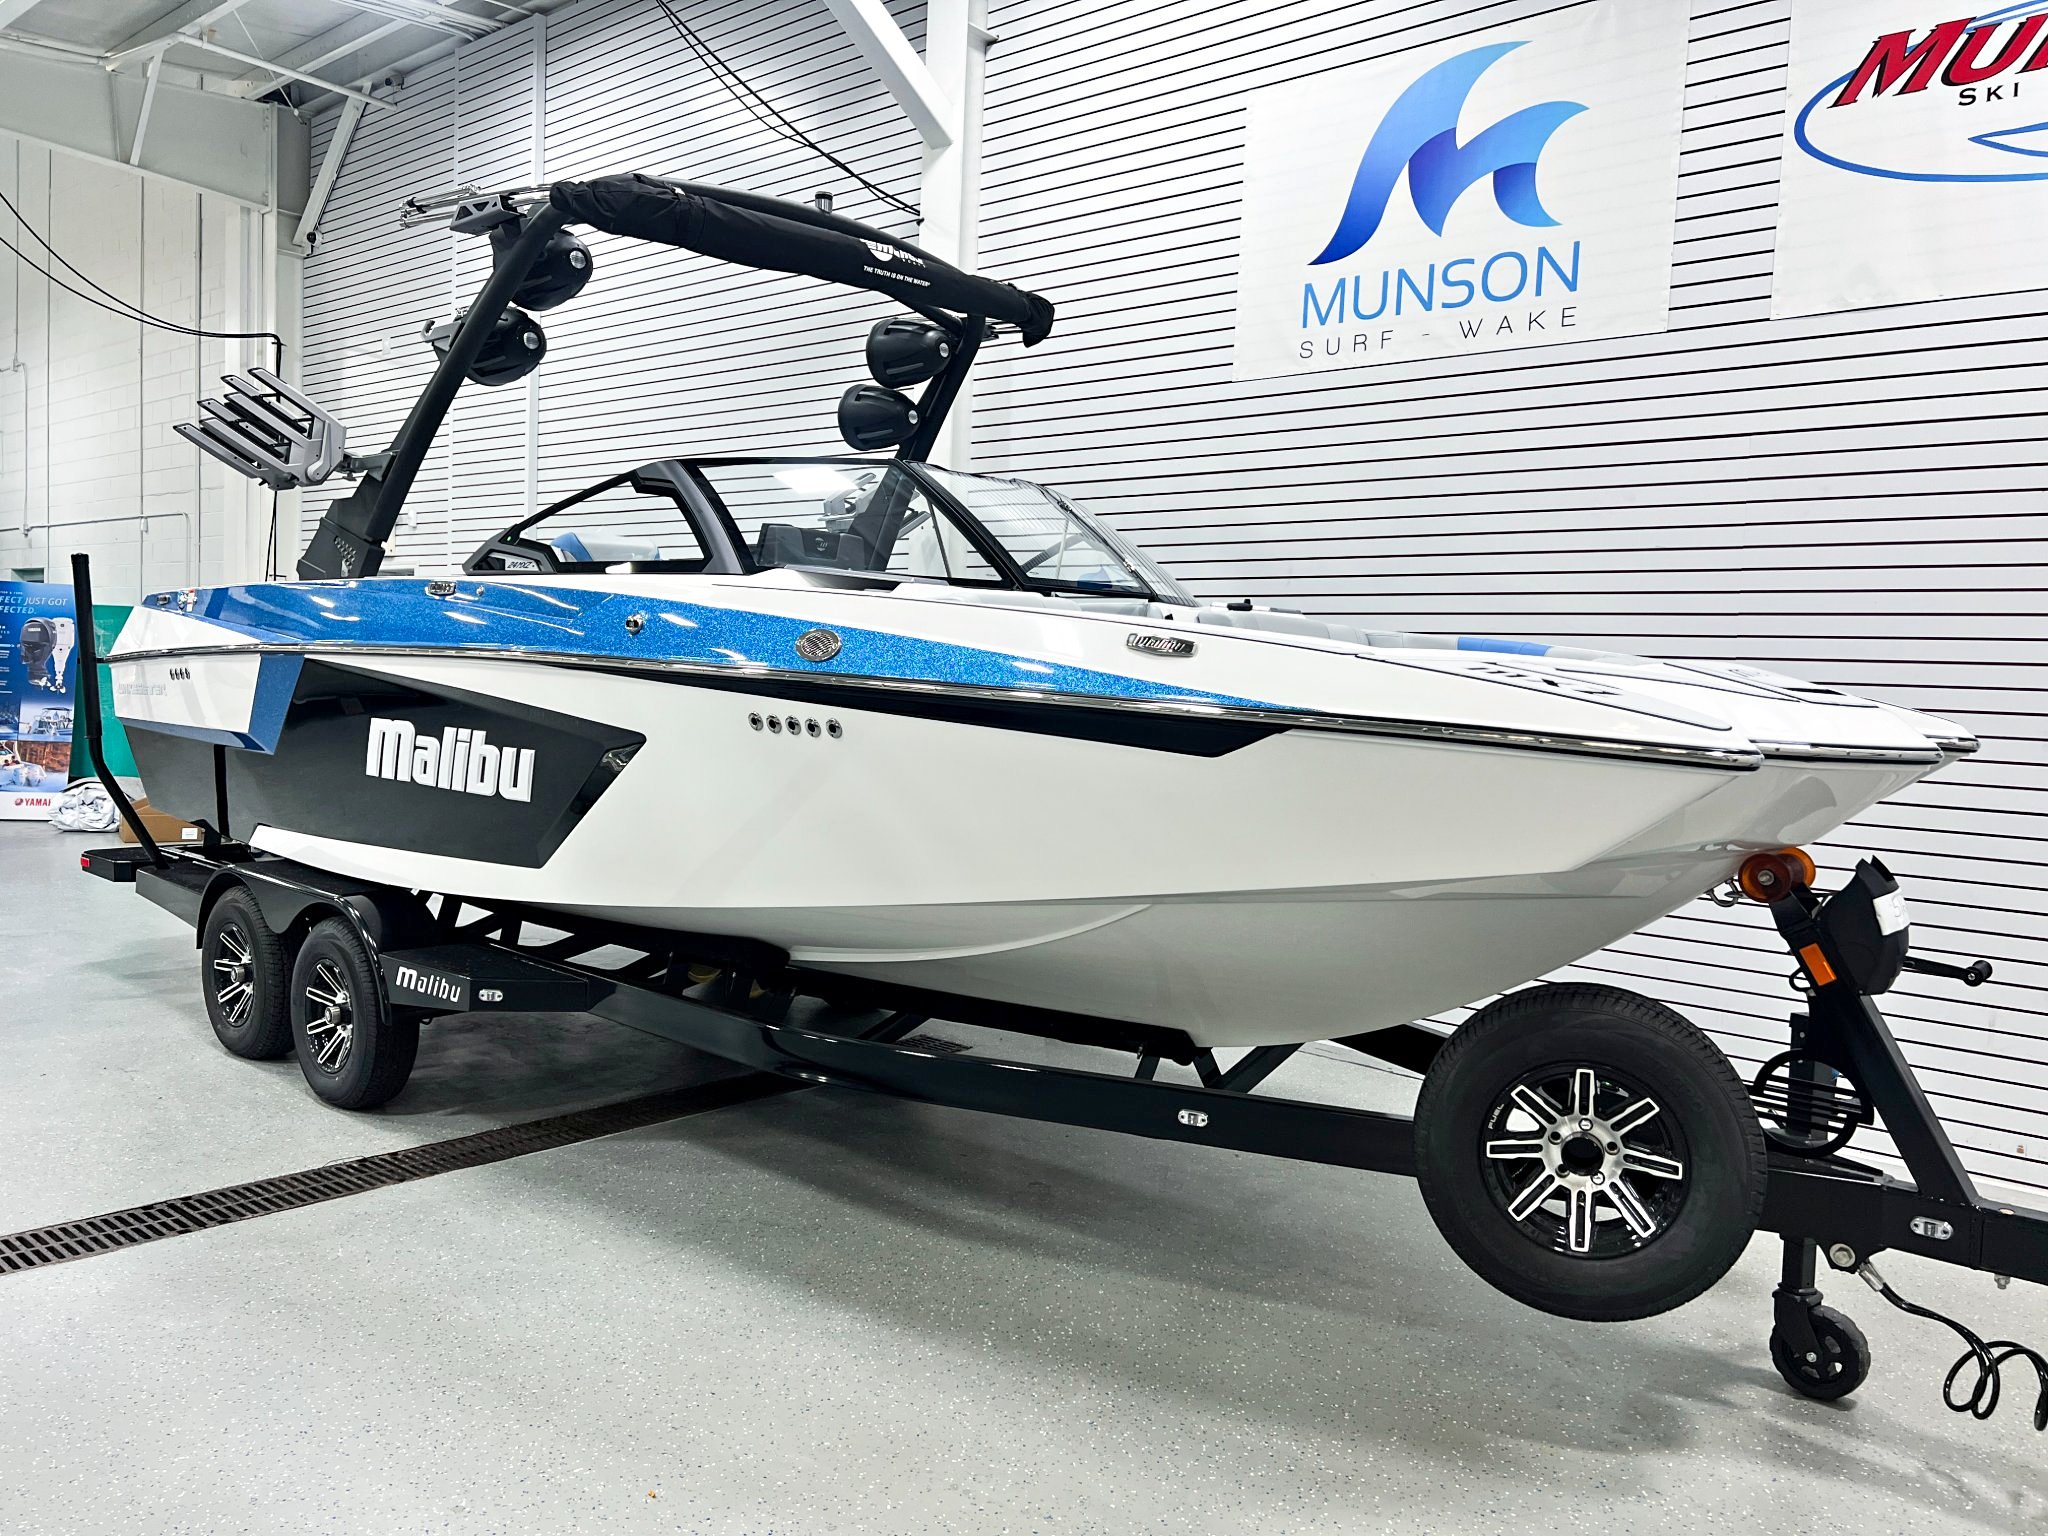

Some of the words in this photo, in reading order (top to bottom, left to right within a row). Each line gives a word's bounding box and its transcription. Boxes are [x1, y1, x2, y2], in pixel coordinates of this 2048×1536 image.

[1826, 13, 2048, 109] MU
[1958, 82, 2019, 106] SKI
[864, 265, 873, 273] THE
[874, 268, 890, 277] TRUTH
[1302, 241, 1580, 328] MUNSON
[1300, 330, 1394, 359] SURF
[1459, 307, 1577, 340] WAKE
[24, 597, 47, 605] JUST
[48, 598, 68, 606] GOT
[1488, 1104, 1504, 1129] FUEL
